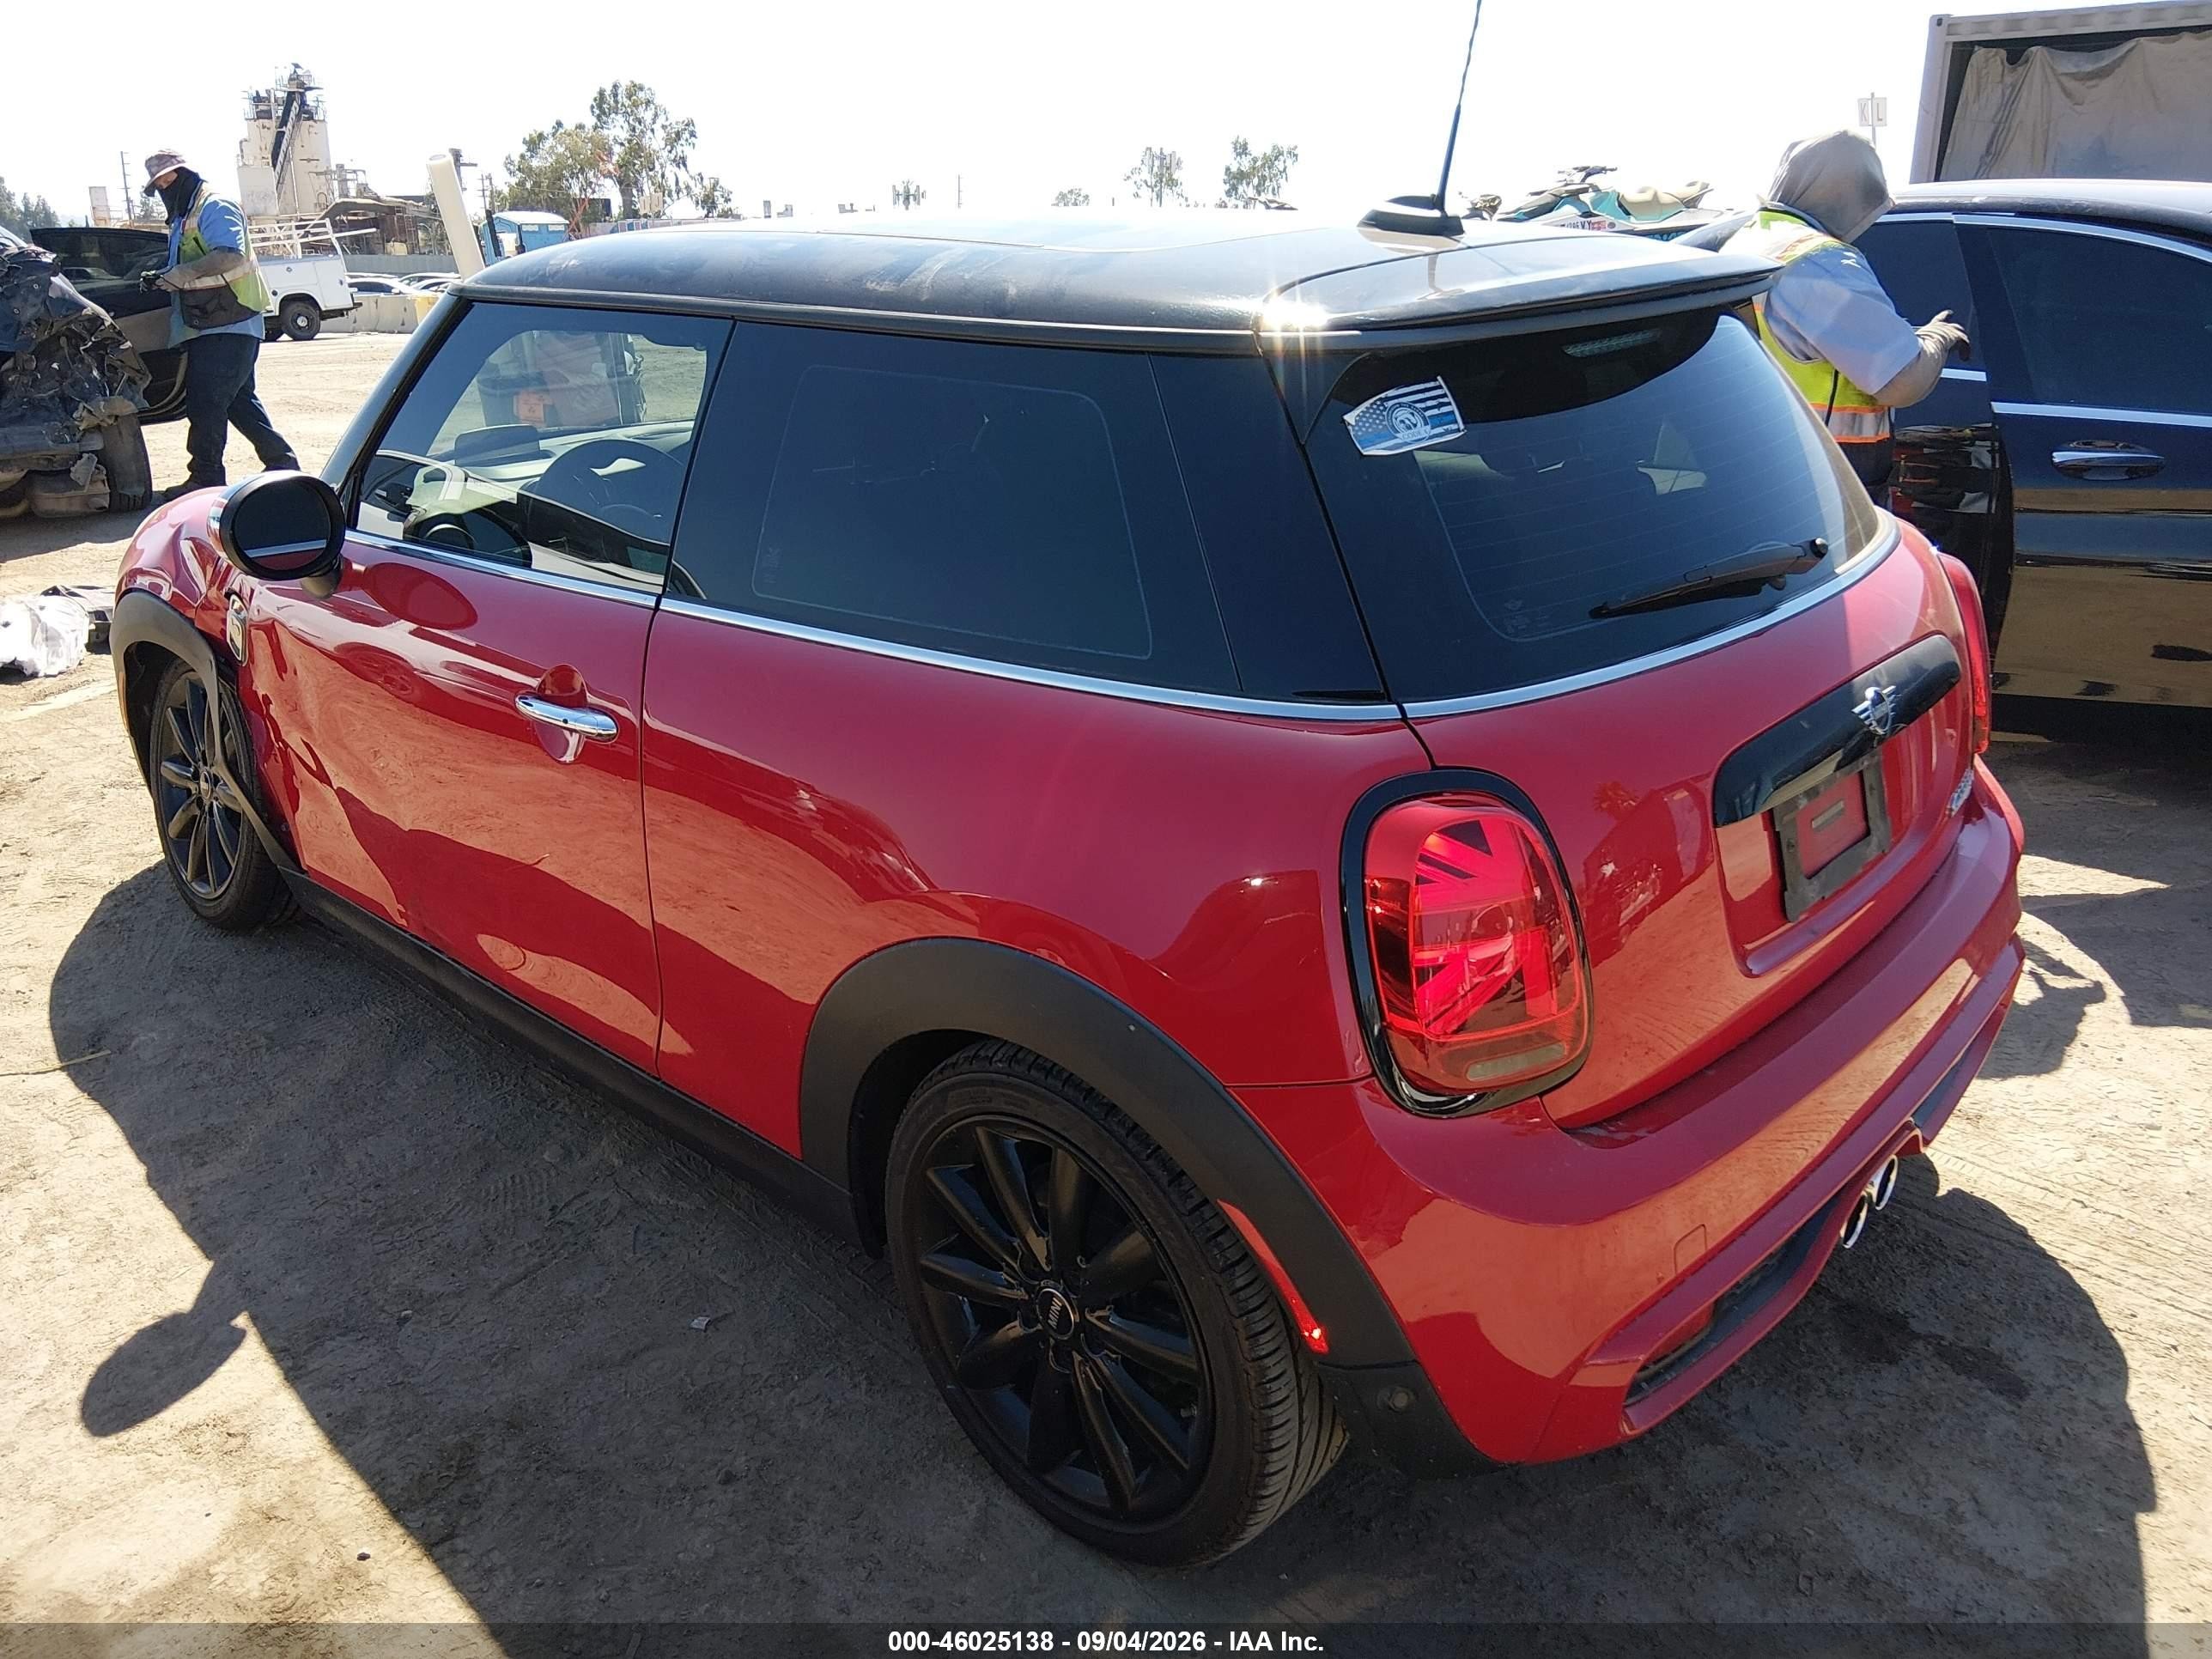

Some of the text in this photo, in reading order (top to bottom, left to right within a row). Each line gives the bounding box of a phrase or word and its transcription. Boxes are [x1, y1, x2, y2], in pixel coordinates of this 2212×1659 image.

[1860, 102, 1868, 122] K
[1876, 102, 1883, 122] L
[1048, 1297, 1062, 1329] MINI
